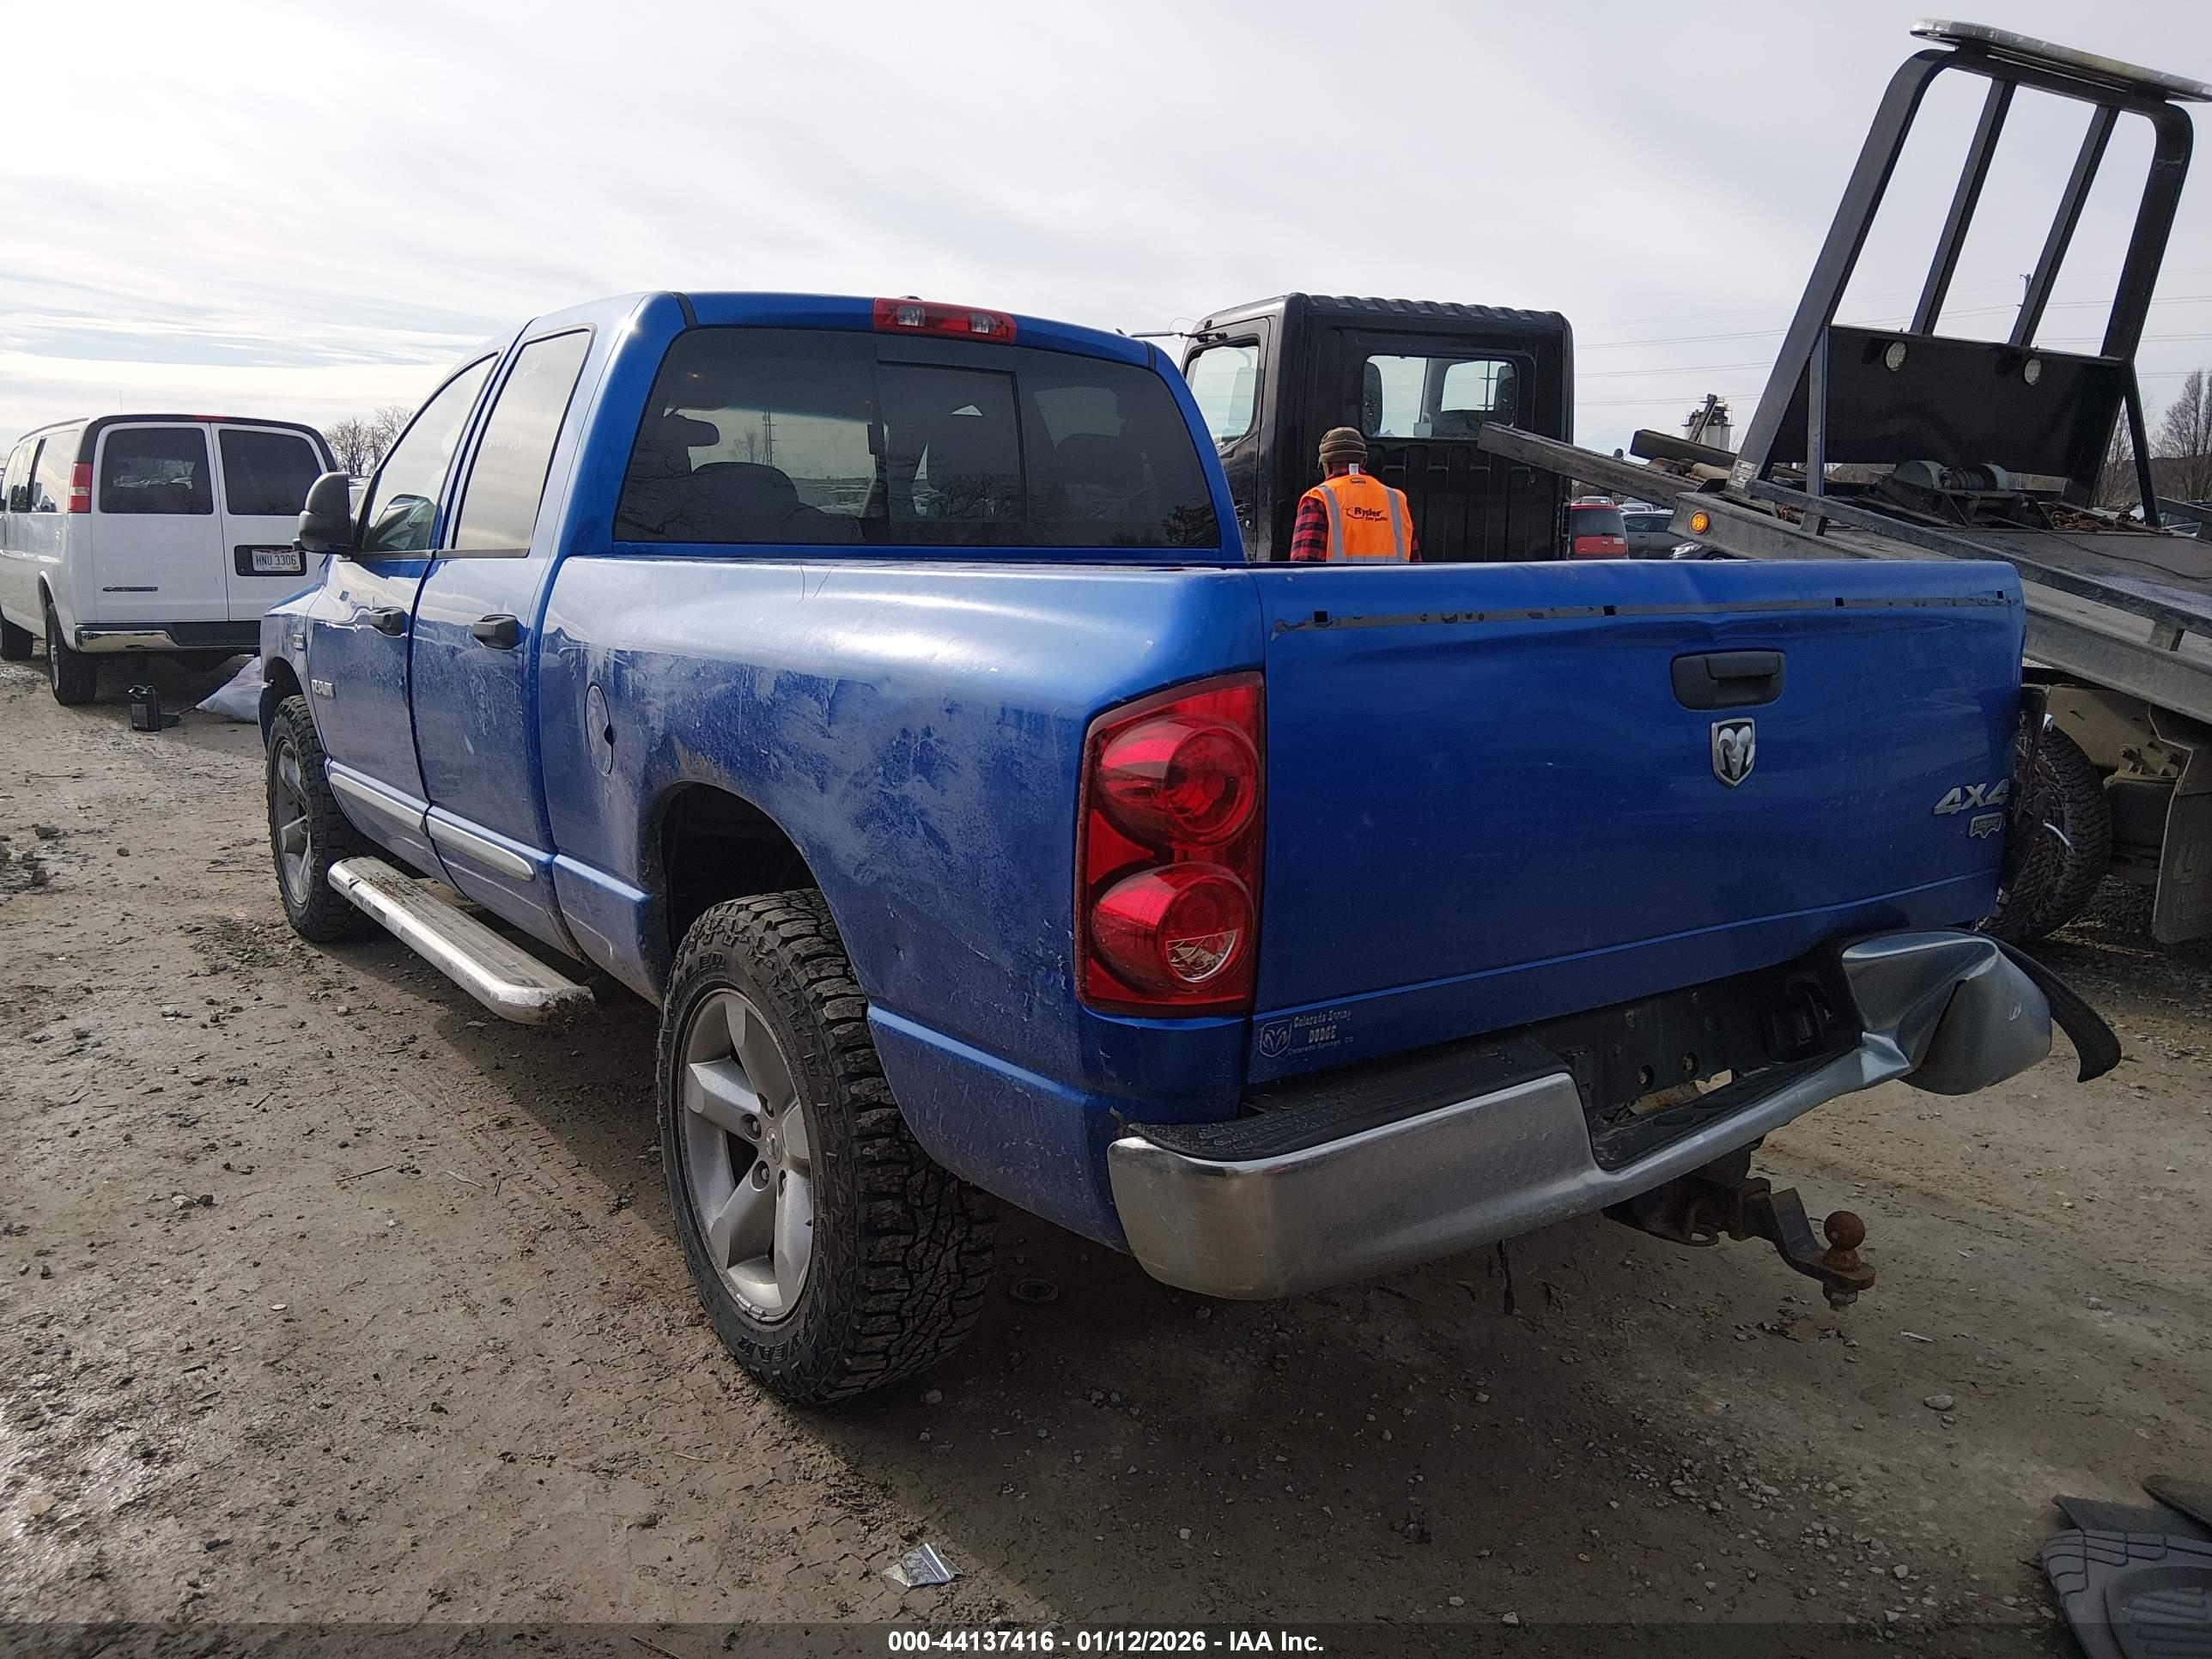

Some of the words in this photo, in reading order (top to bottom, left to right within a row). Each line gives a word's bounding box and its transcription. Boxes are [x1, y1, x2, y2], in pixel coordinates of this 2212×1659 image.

[1354, 507, 1383, 517] Ryder
[255, 555, 272, 566] HNU
[275, 555, 296, 566] 3306
[1293, 1012, 1327, 1027] Colorado
[1308, 1024, 1337, 1044] DODGE
